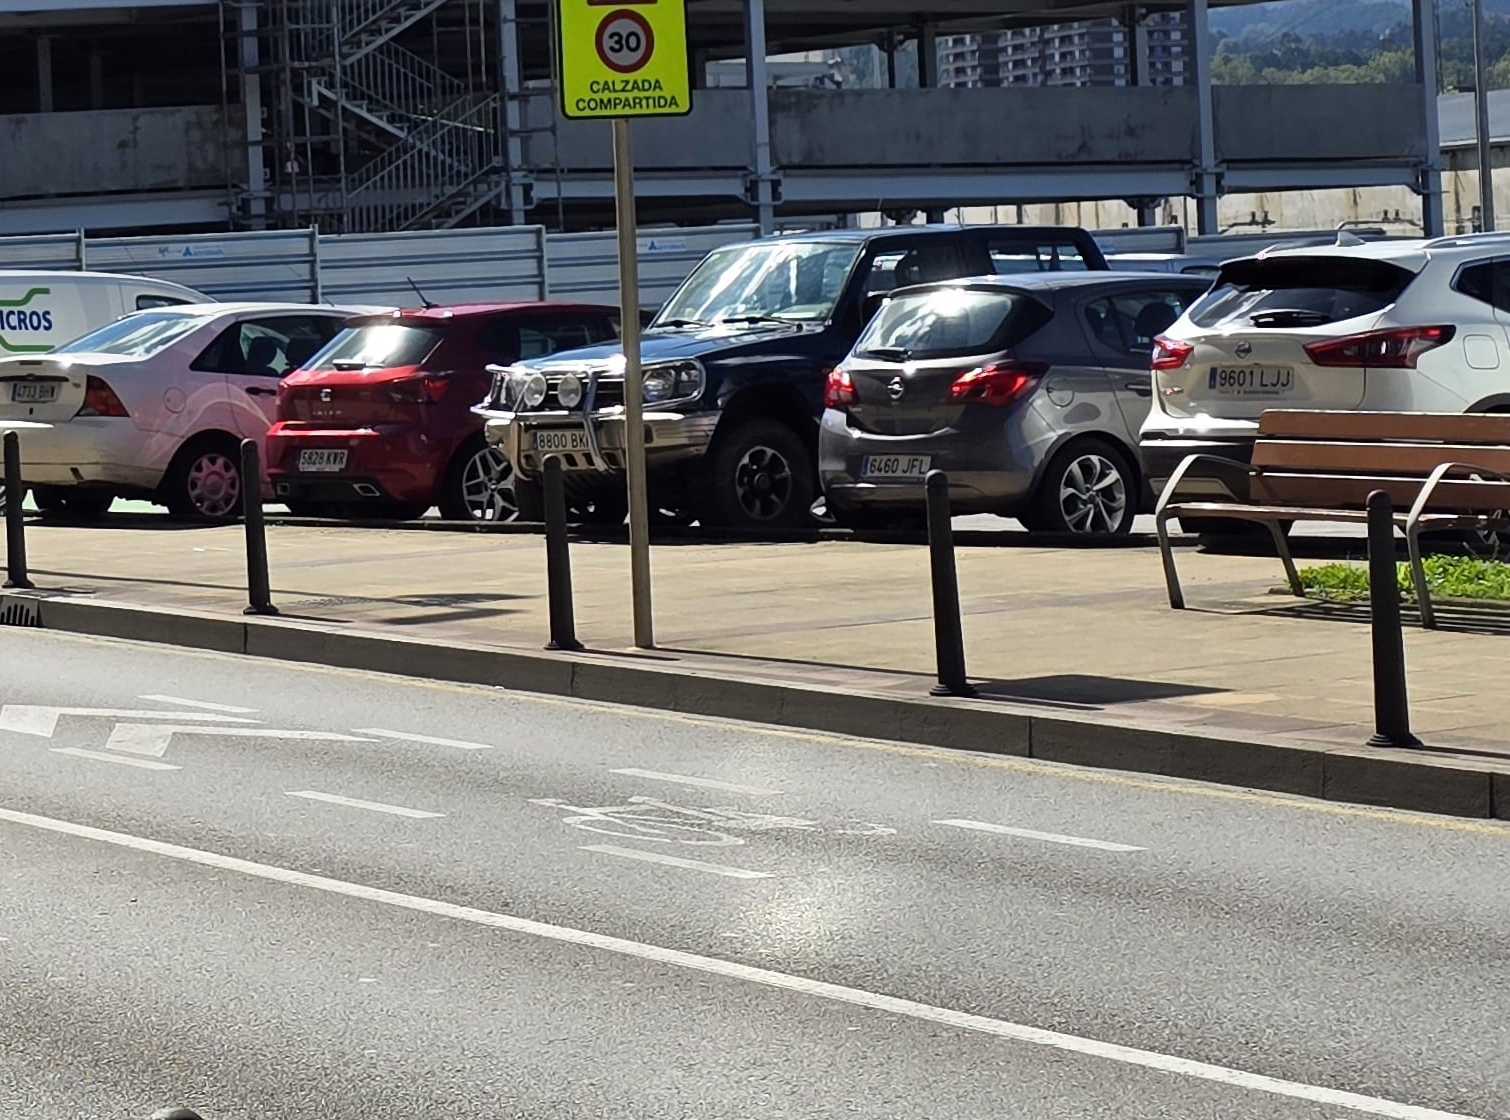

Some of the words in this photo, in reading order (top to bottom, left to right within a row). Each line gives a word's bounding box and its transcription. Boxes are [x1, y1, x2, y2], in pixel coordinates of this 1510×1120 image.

[608, 31, 641, 53] 30
[589, 78, 663, 94] CALZADA
[575, 95, 679, 112] COMPARTIDA
[1219, 369, 1254, 387] 9601
[1260, 370, 1291, 387] LJJ
[539, 433, 567, 449] 8800
[869, 458, 900, 474] 6460
[902, 458, 926, 474] JFL
